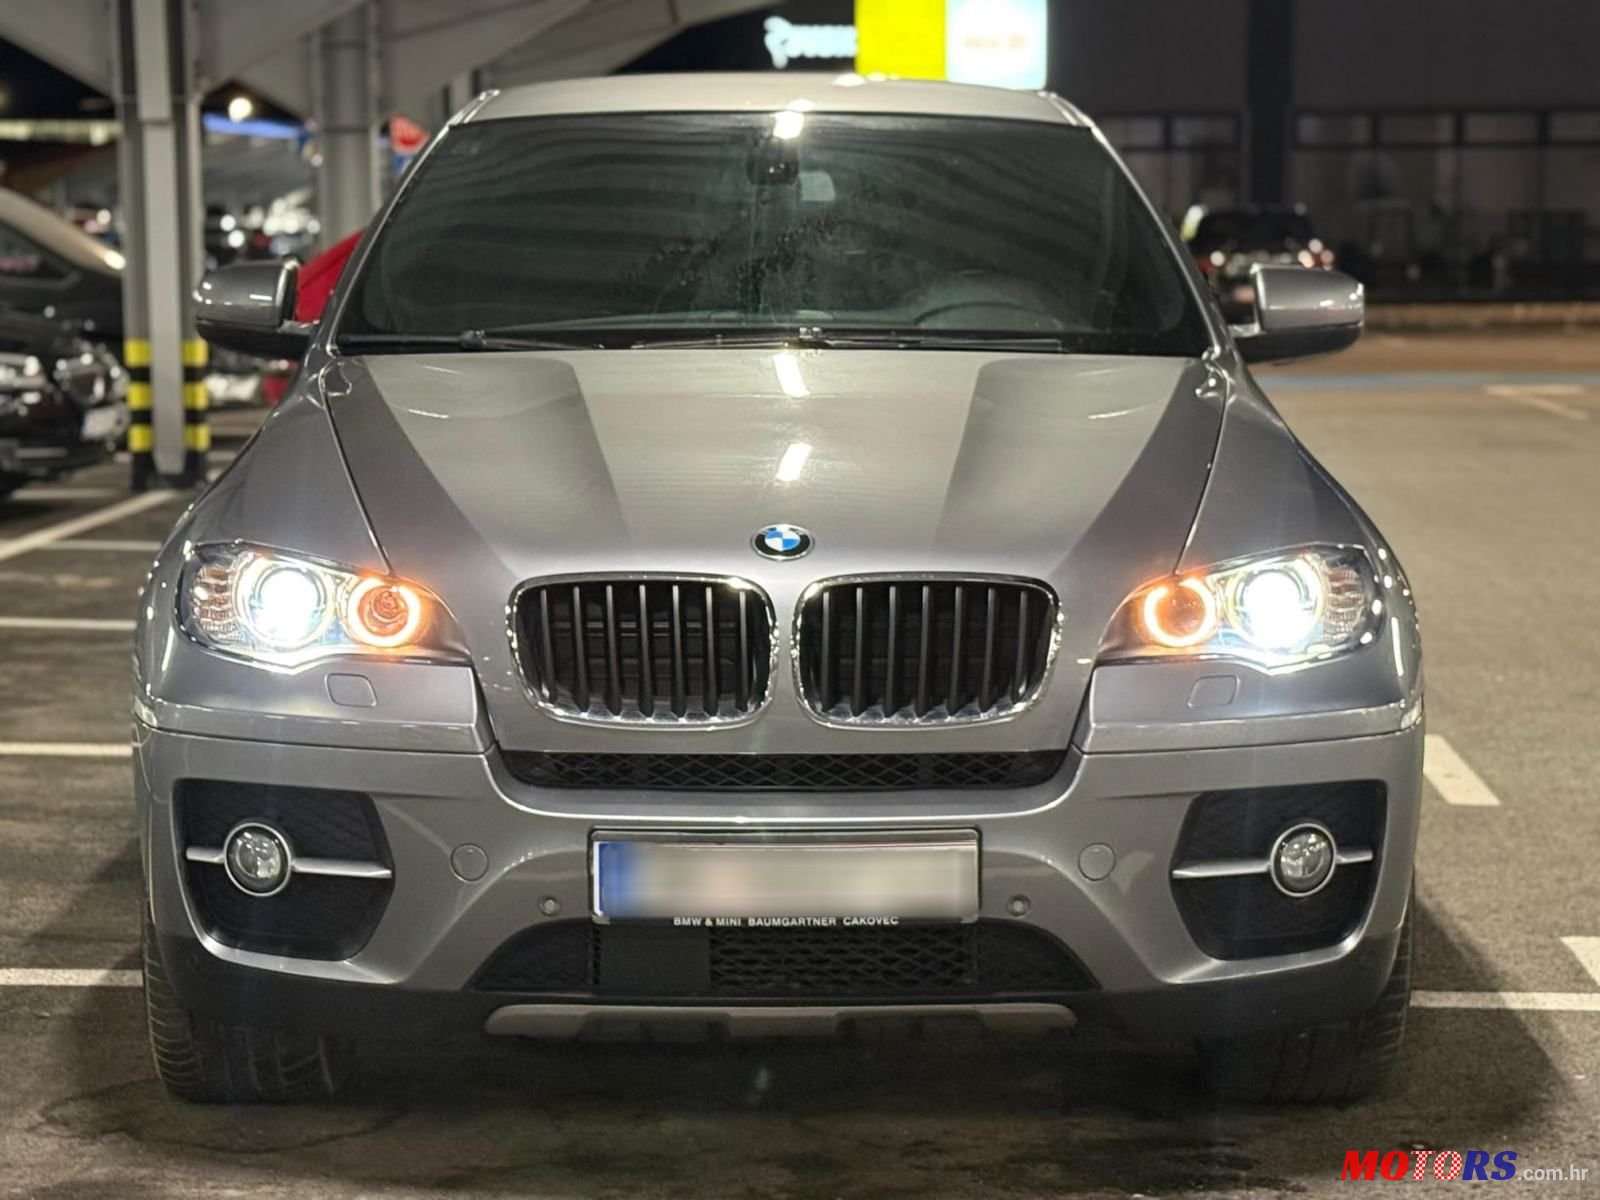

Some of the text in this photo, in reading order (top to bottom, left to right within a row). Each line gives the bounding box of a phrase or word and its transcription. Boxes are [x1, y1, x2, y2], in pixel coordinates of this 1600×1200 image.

[673, 916, 701, 927] BMW
[705, 916, 713, 927] &
[716, 916, 742, 927] MINI
[748, 916, 837, 927] BAUMGARTNER
